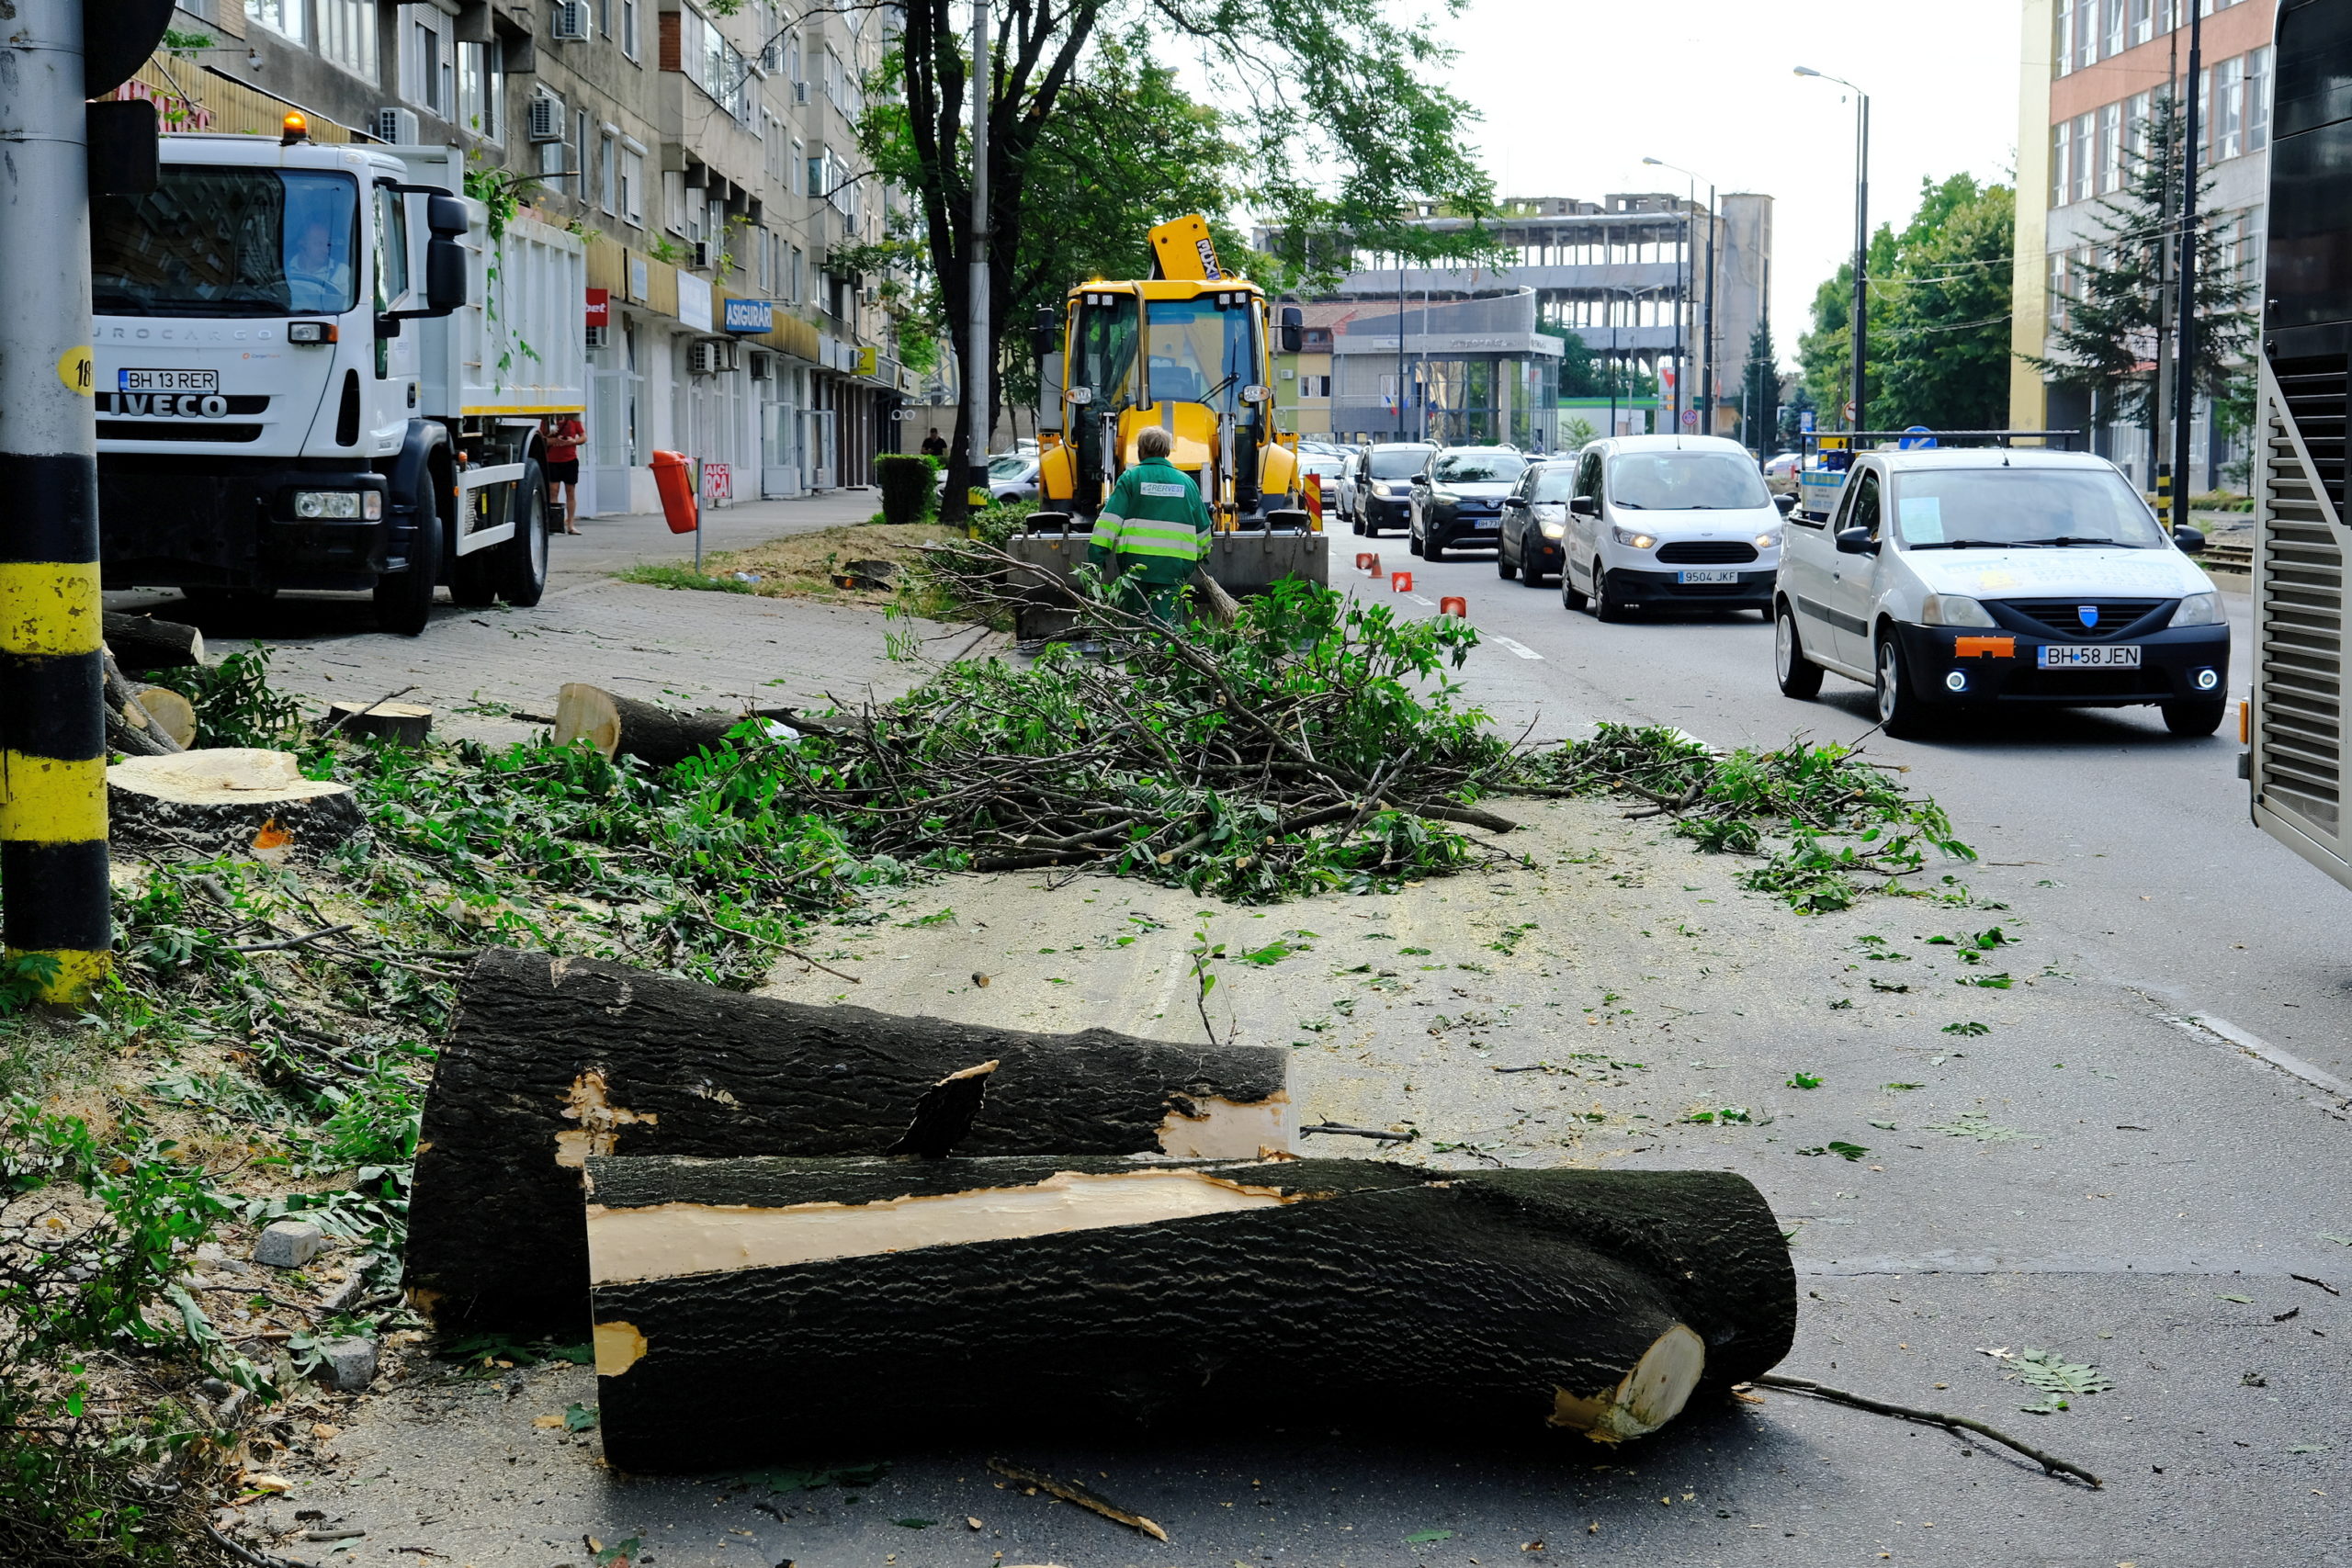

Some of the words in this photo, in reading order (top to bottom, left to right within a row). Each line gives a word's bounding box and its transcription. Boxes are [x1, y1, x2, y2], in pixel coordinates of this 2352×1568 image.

[130, 372, 153, 388] BH
[158, 372, 174, 388] 13
[178, 373, 214, 389] RER
[109, 394, 228, 419] IVECO
[705, 464, 729, 475] AICI
[705, 474, 729, 498] RCA
[1685, 571, 1713, 582] 9504
[1716, 571, 1736, 581] JKF
[2048, 648, 2074, 664] BH
[2081, 648, 2101, 664] 58
[2105, 648, 2138, 664] JEN
